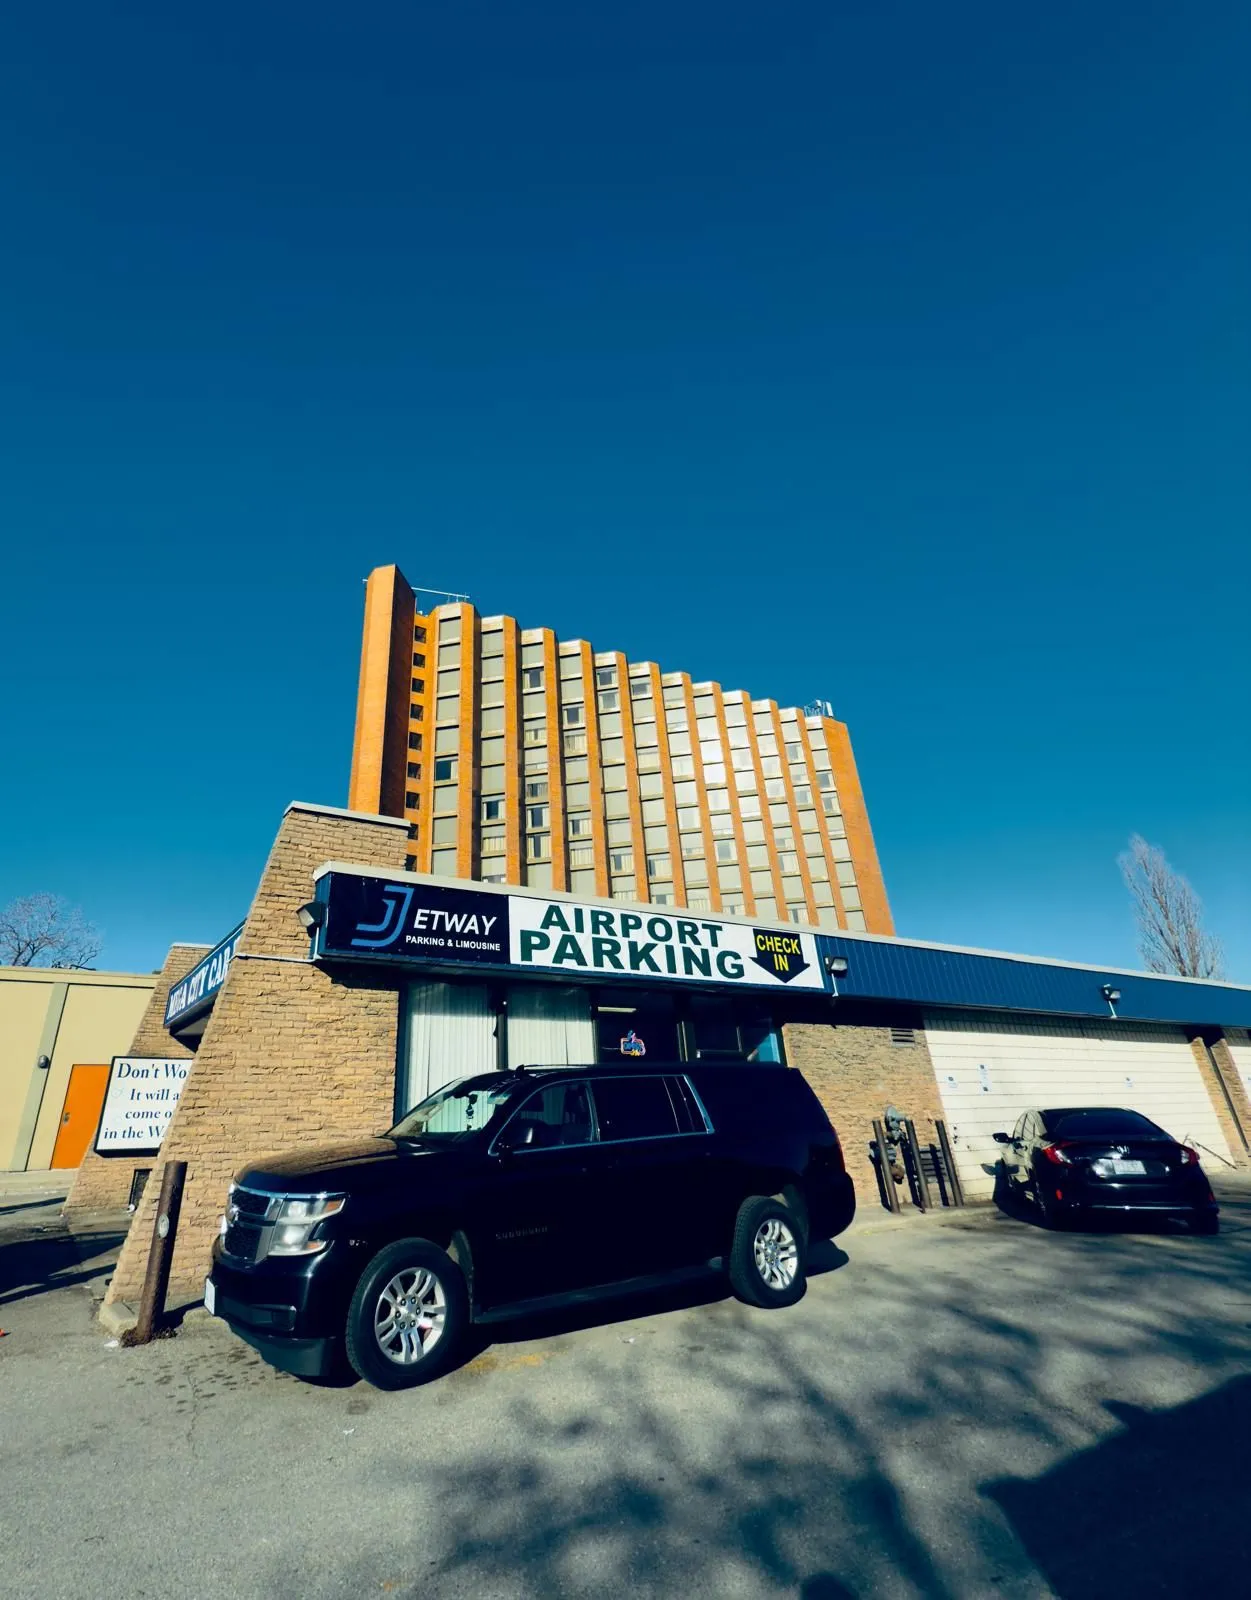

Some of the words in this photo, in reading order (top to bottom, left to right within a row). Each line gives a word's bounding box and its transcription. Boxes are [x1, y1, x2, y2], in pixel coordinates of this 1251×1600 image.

[539, 904, 723, 948] AIRPORT
[405, 935, 445, 947] PARKING
[447, 937, 453, 947] &
[455, 939, 501, 951] LIMOUSINE
[756, 934, 801, 955] CHECK
[519, 929, 745, 979] PARKING
[773, 954, 789, 972] IN
[187, 963, 210, 1005] CITY
[117, 1062, 160, 1079] Don't
[164, 1063, 187, 1079] Wo
[130, 1088, 141, 1101] It
[145, 1088, 170, 1101] will
[125, 1109, 161, 1120] come
[104, 1127, 118, 1139] in
[122, 1126, 144, 1139] the
[148, 1125, 165, 1139] W
